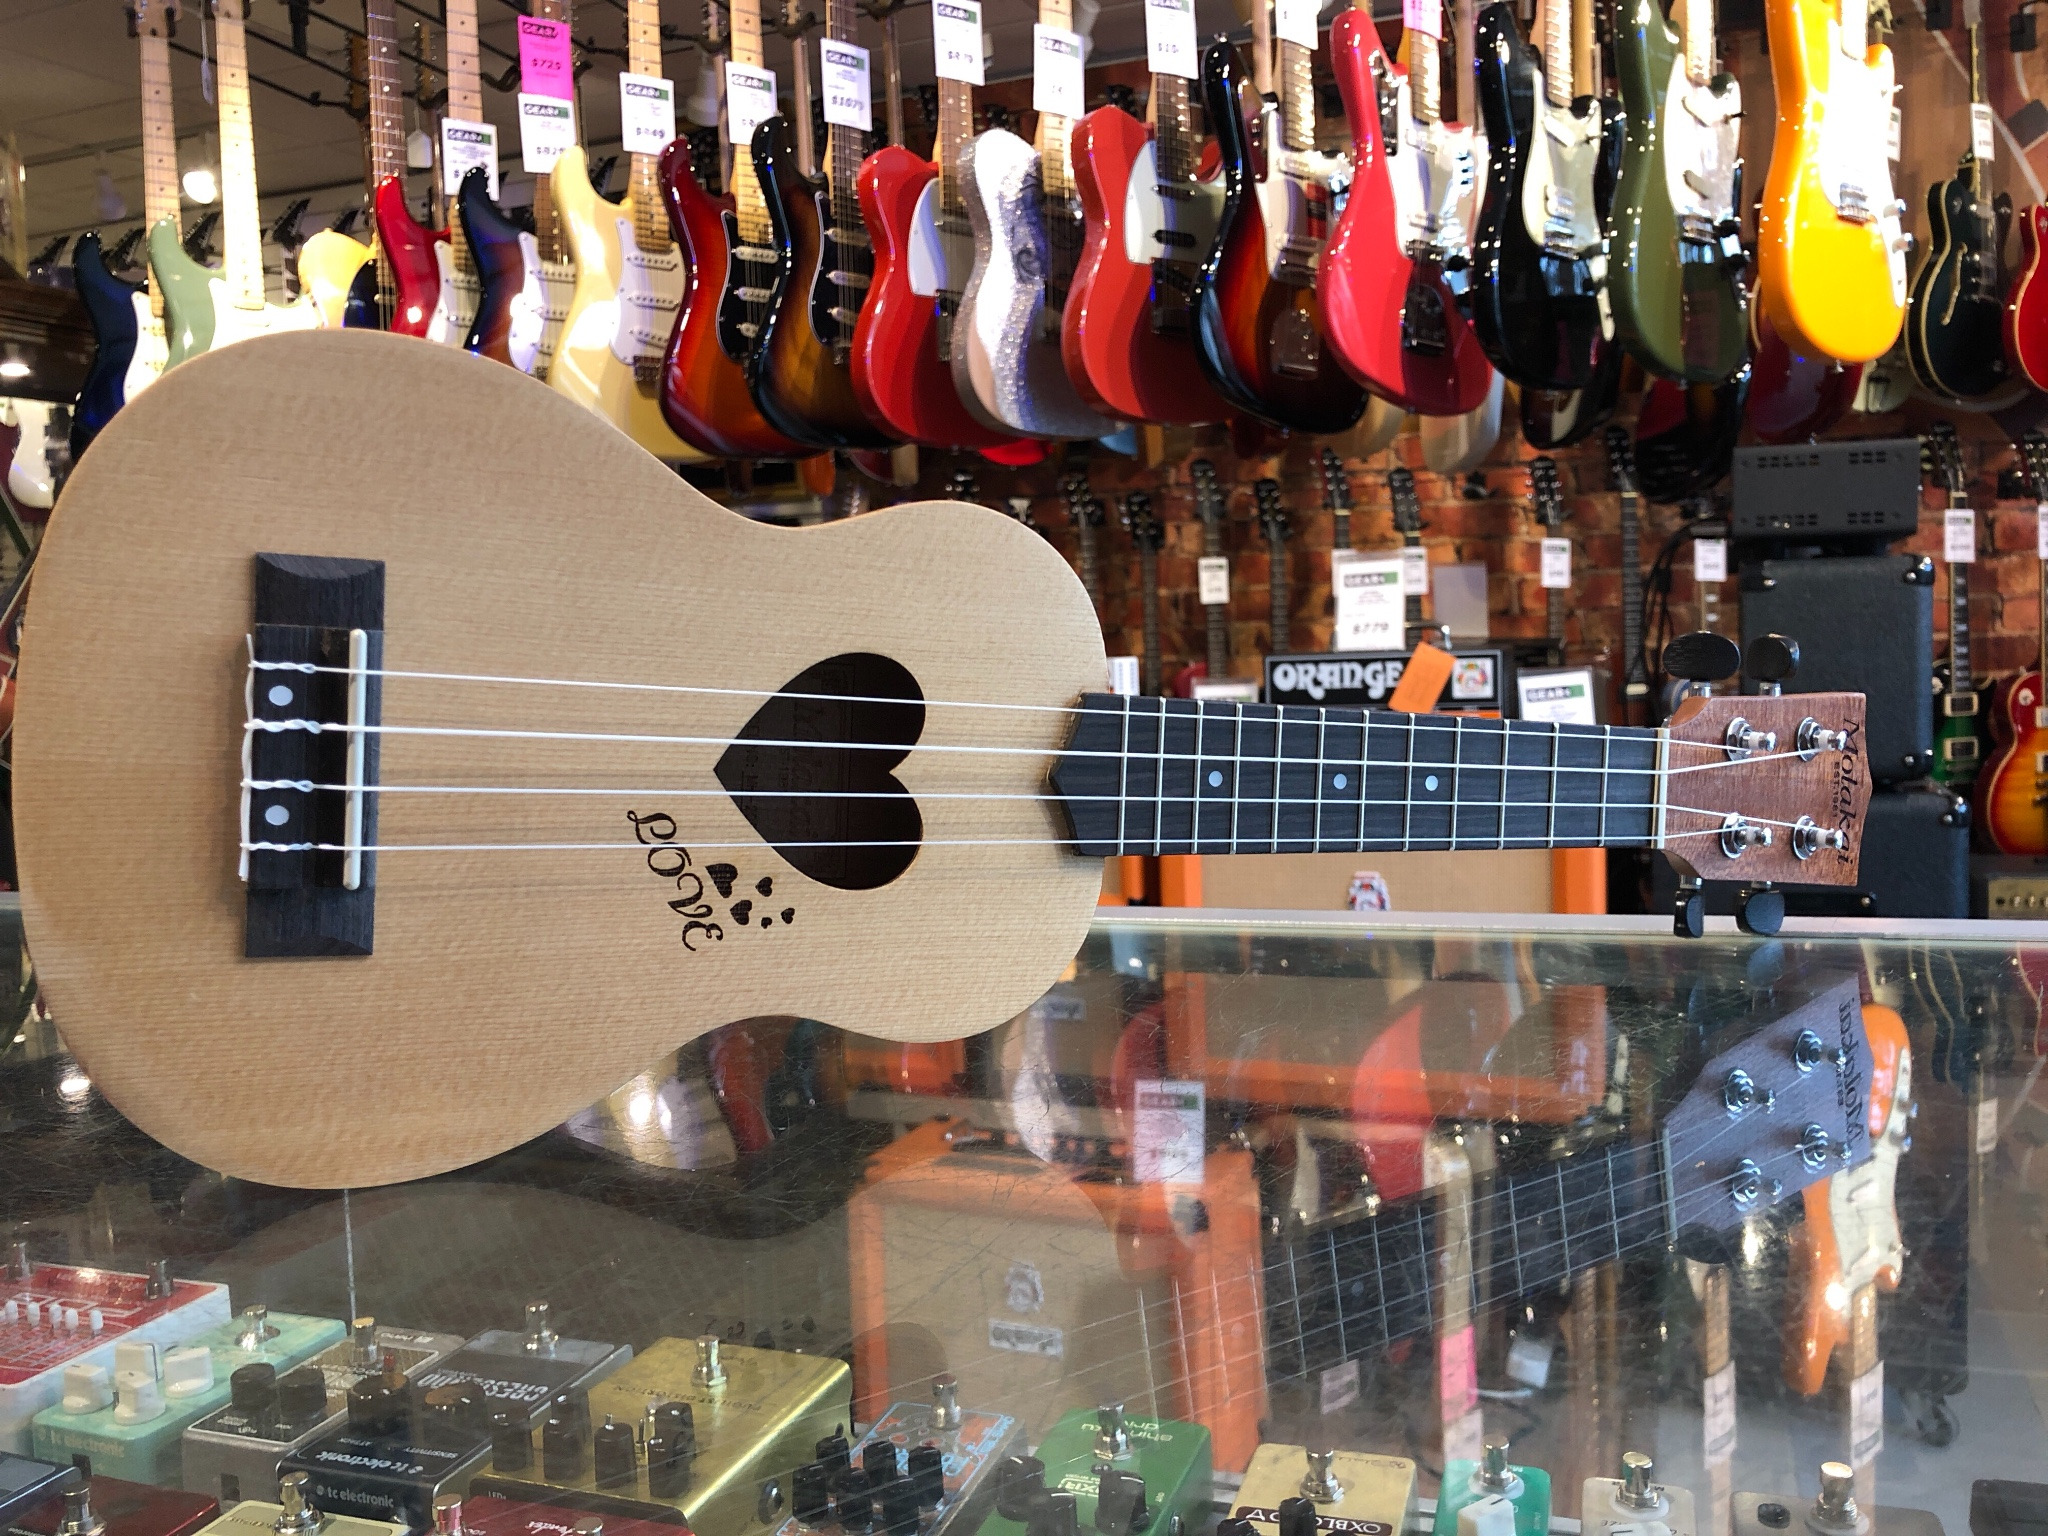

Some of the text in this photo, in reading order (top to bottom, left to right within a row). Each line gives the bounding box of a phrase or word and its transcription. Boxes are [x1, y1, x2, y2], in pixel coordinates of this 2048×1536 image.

[1272, 659, 1403, 701] ORANGE
[51, 1433, 126, 1459] tc electronic
[315, 1449, 407, 1474] tc electronic
[327, 1487, 395, 1509] tc electronic
[1270, 1512, 1382, 1534] OXBLD
